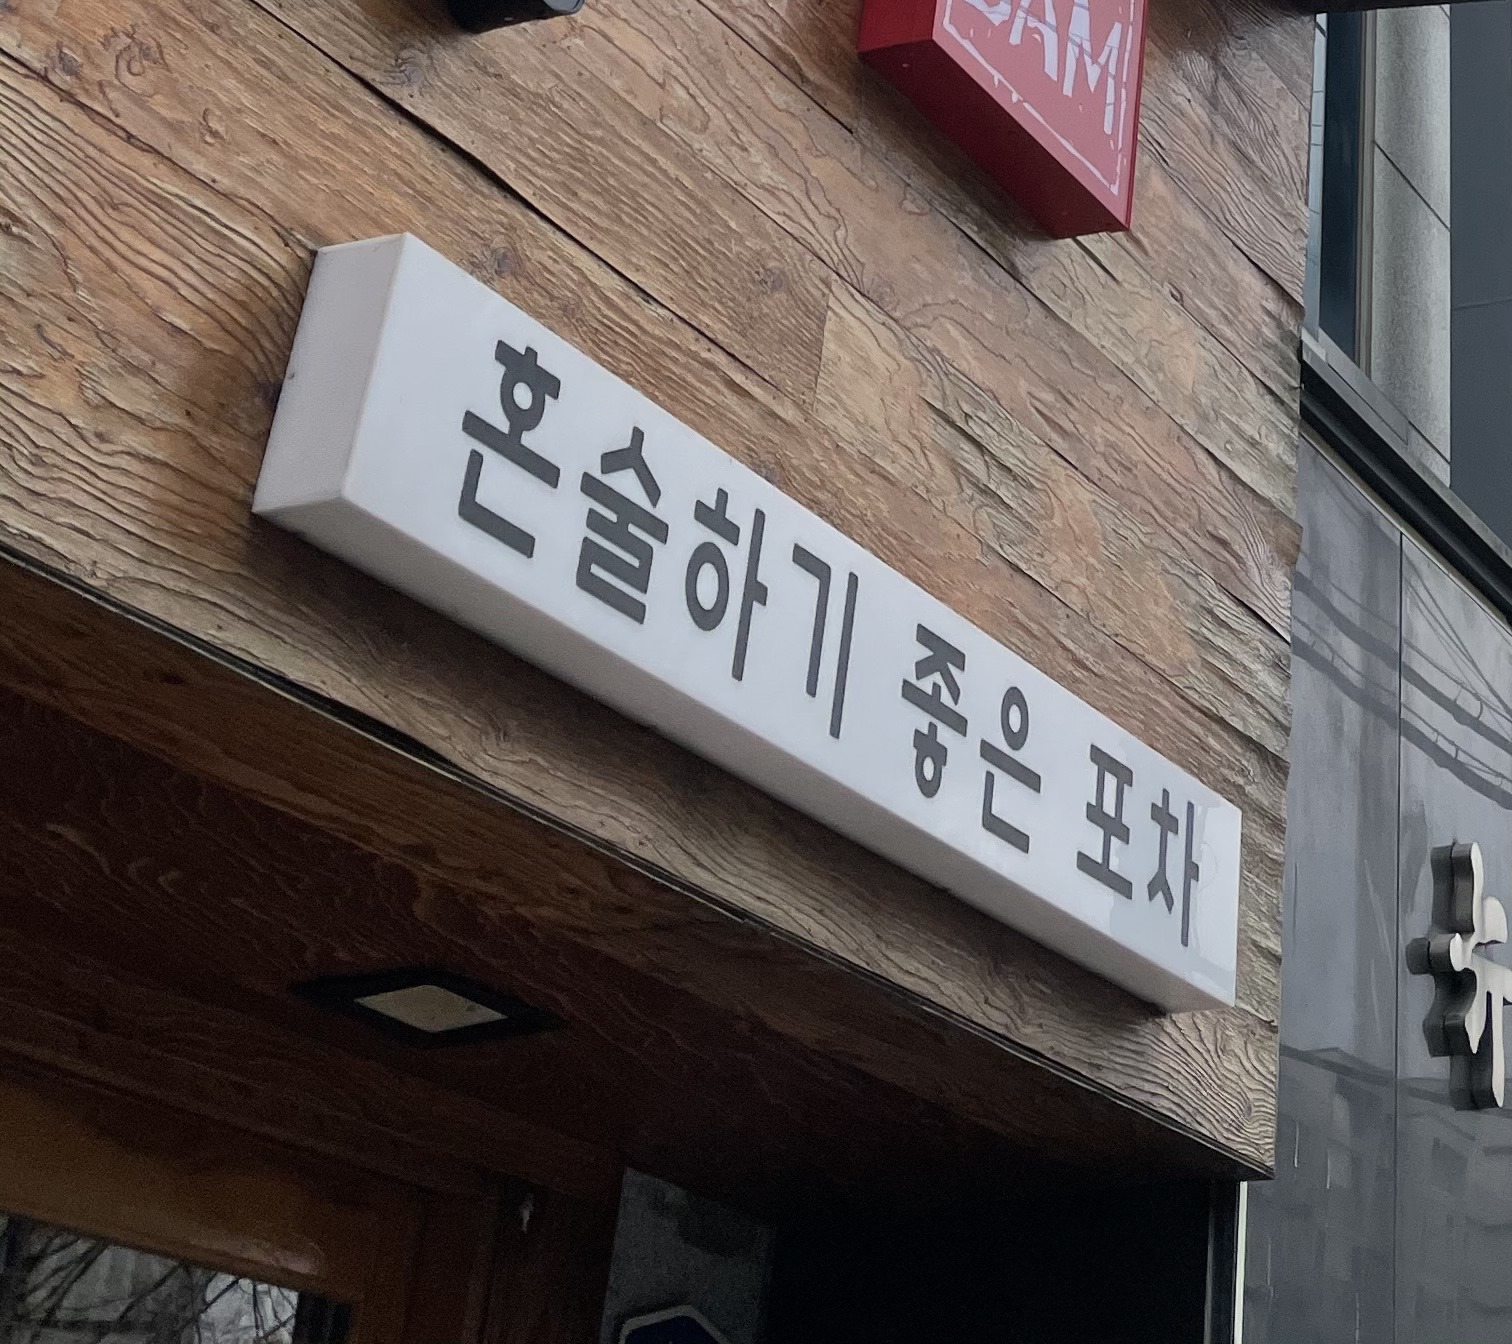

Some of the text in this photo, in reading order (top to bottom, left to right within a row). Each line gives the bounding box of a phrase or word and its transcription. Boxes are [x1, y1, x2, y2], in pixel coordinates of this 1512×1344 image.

[458, 338, 1201, 948] 혼술하기 좋은 포차
